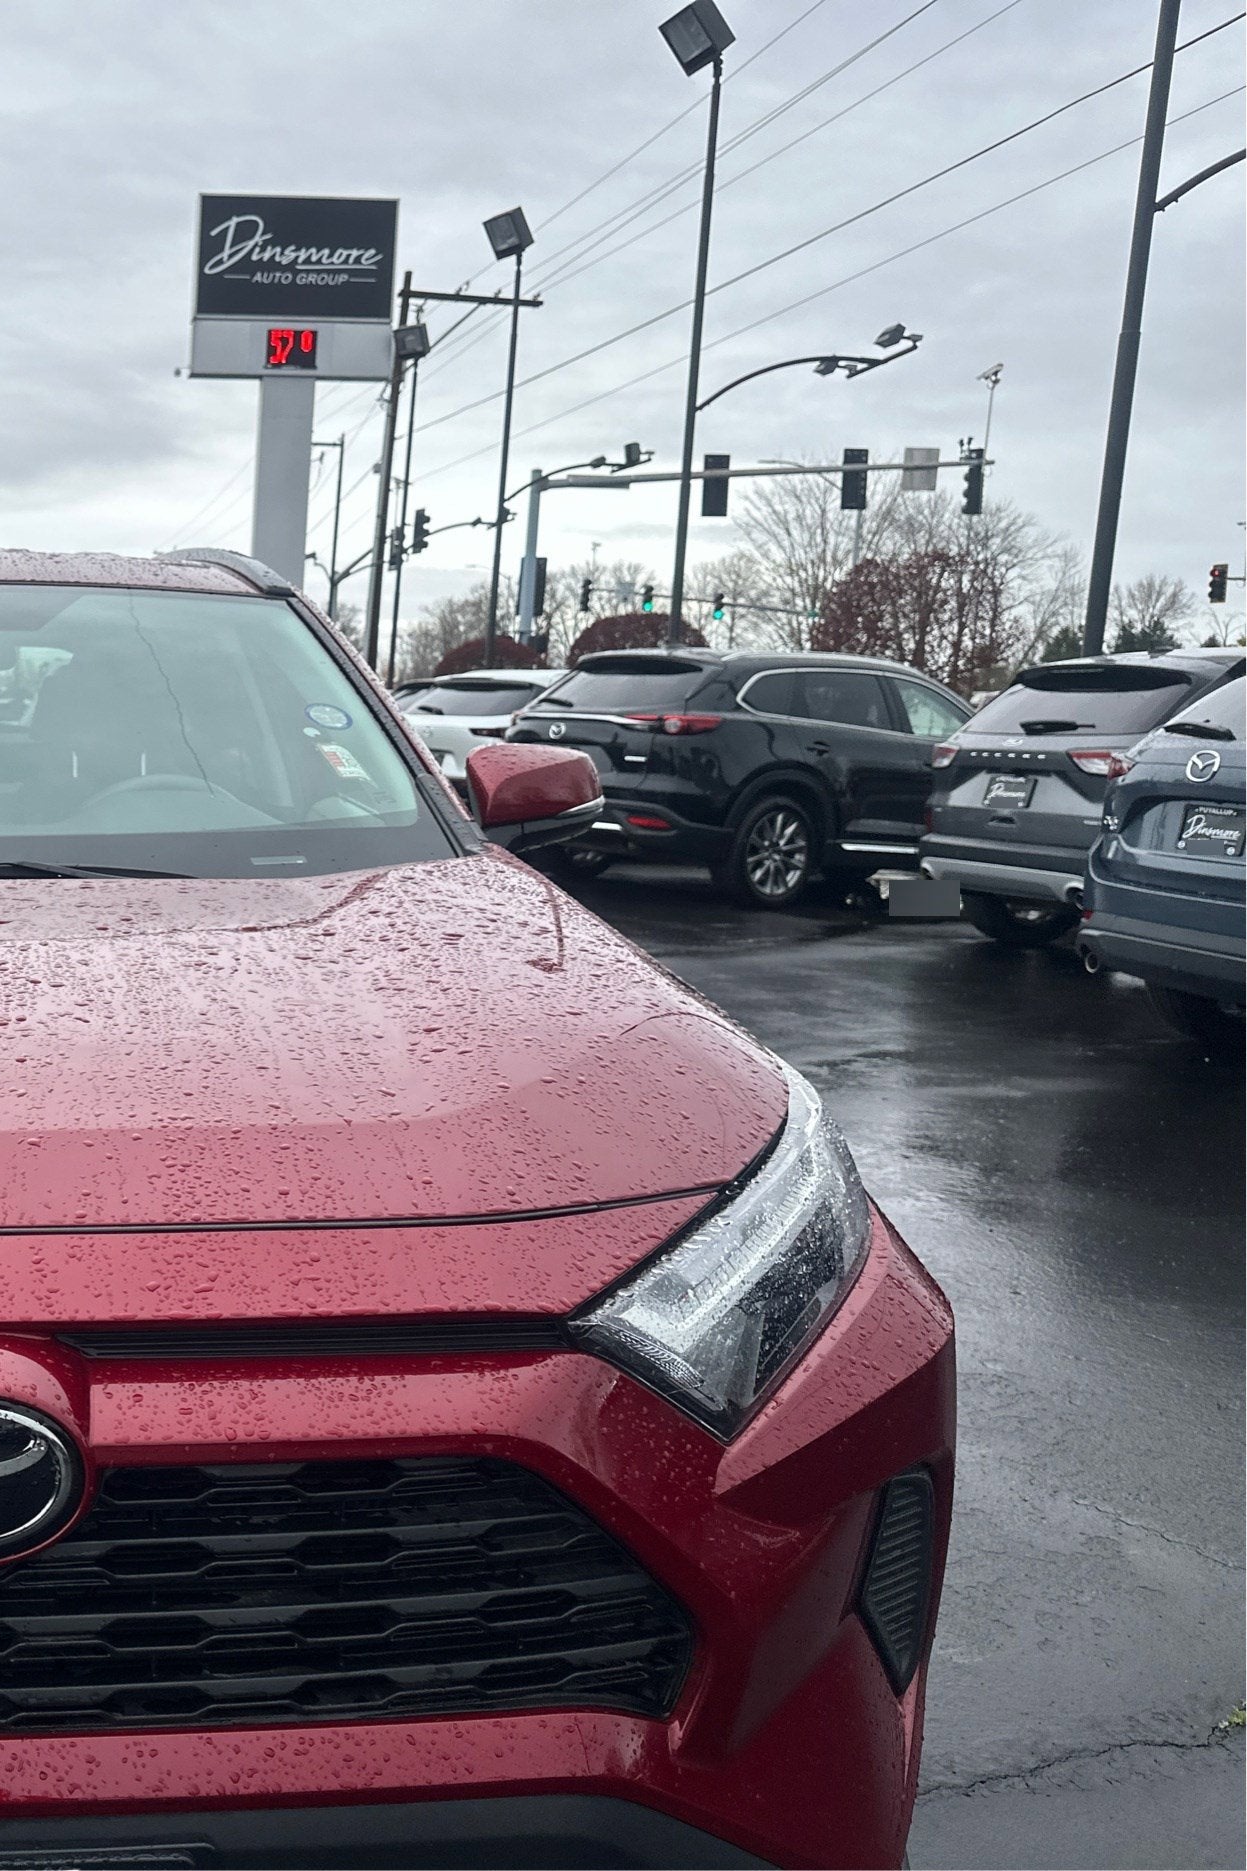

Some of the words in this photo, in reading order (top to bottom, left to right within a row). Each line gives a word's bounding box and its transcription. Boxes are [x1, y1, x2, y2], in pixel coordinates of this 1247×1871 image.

[204, 215, 383, 274] Dinsmore
[252, 271, 293, 284] AUTO
[296, 273, 349, 286] GROUP
[1182, 815, 1241, 840] Dinsmore
